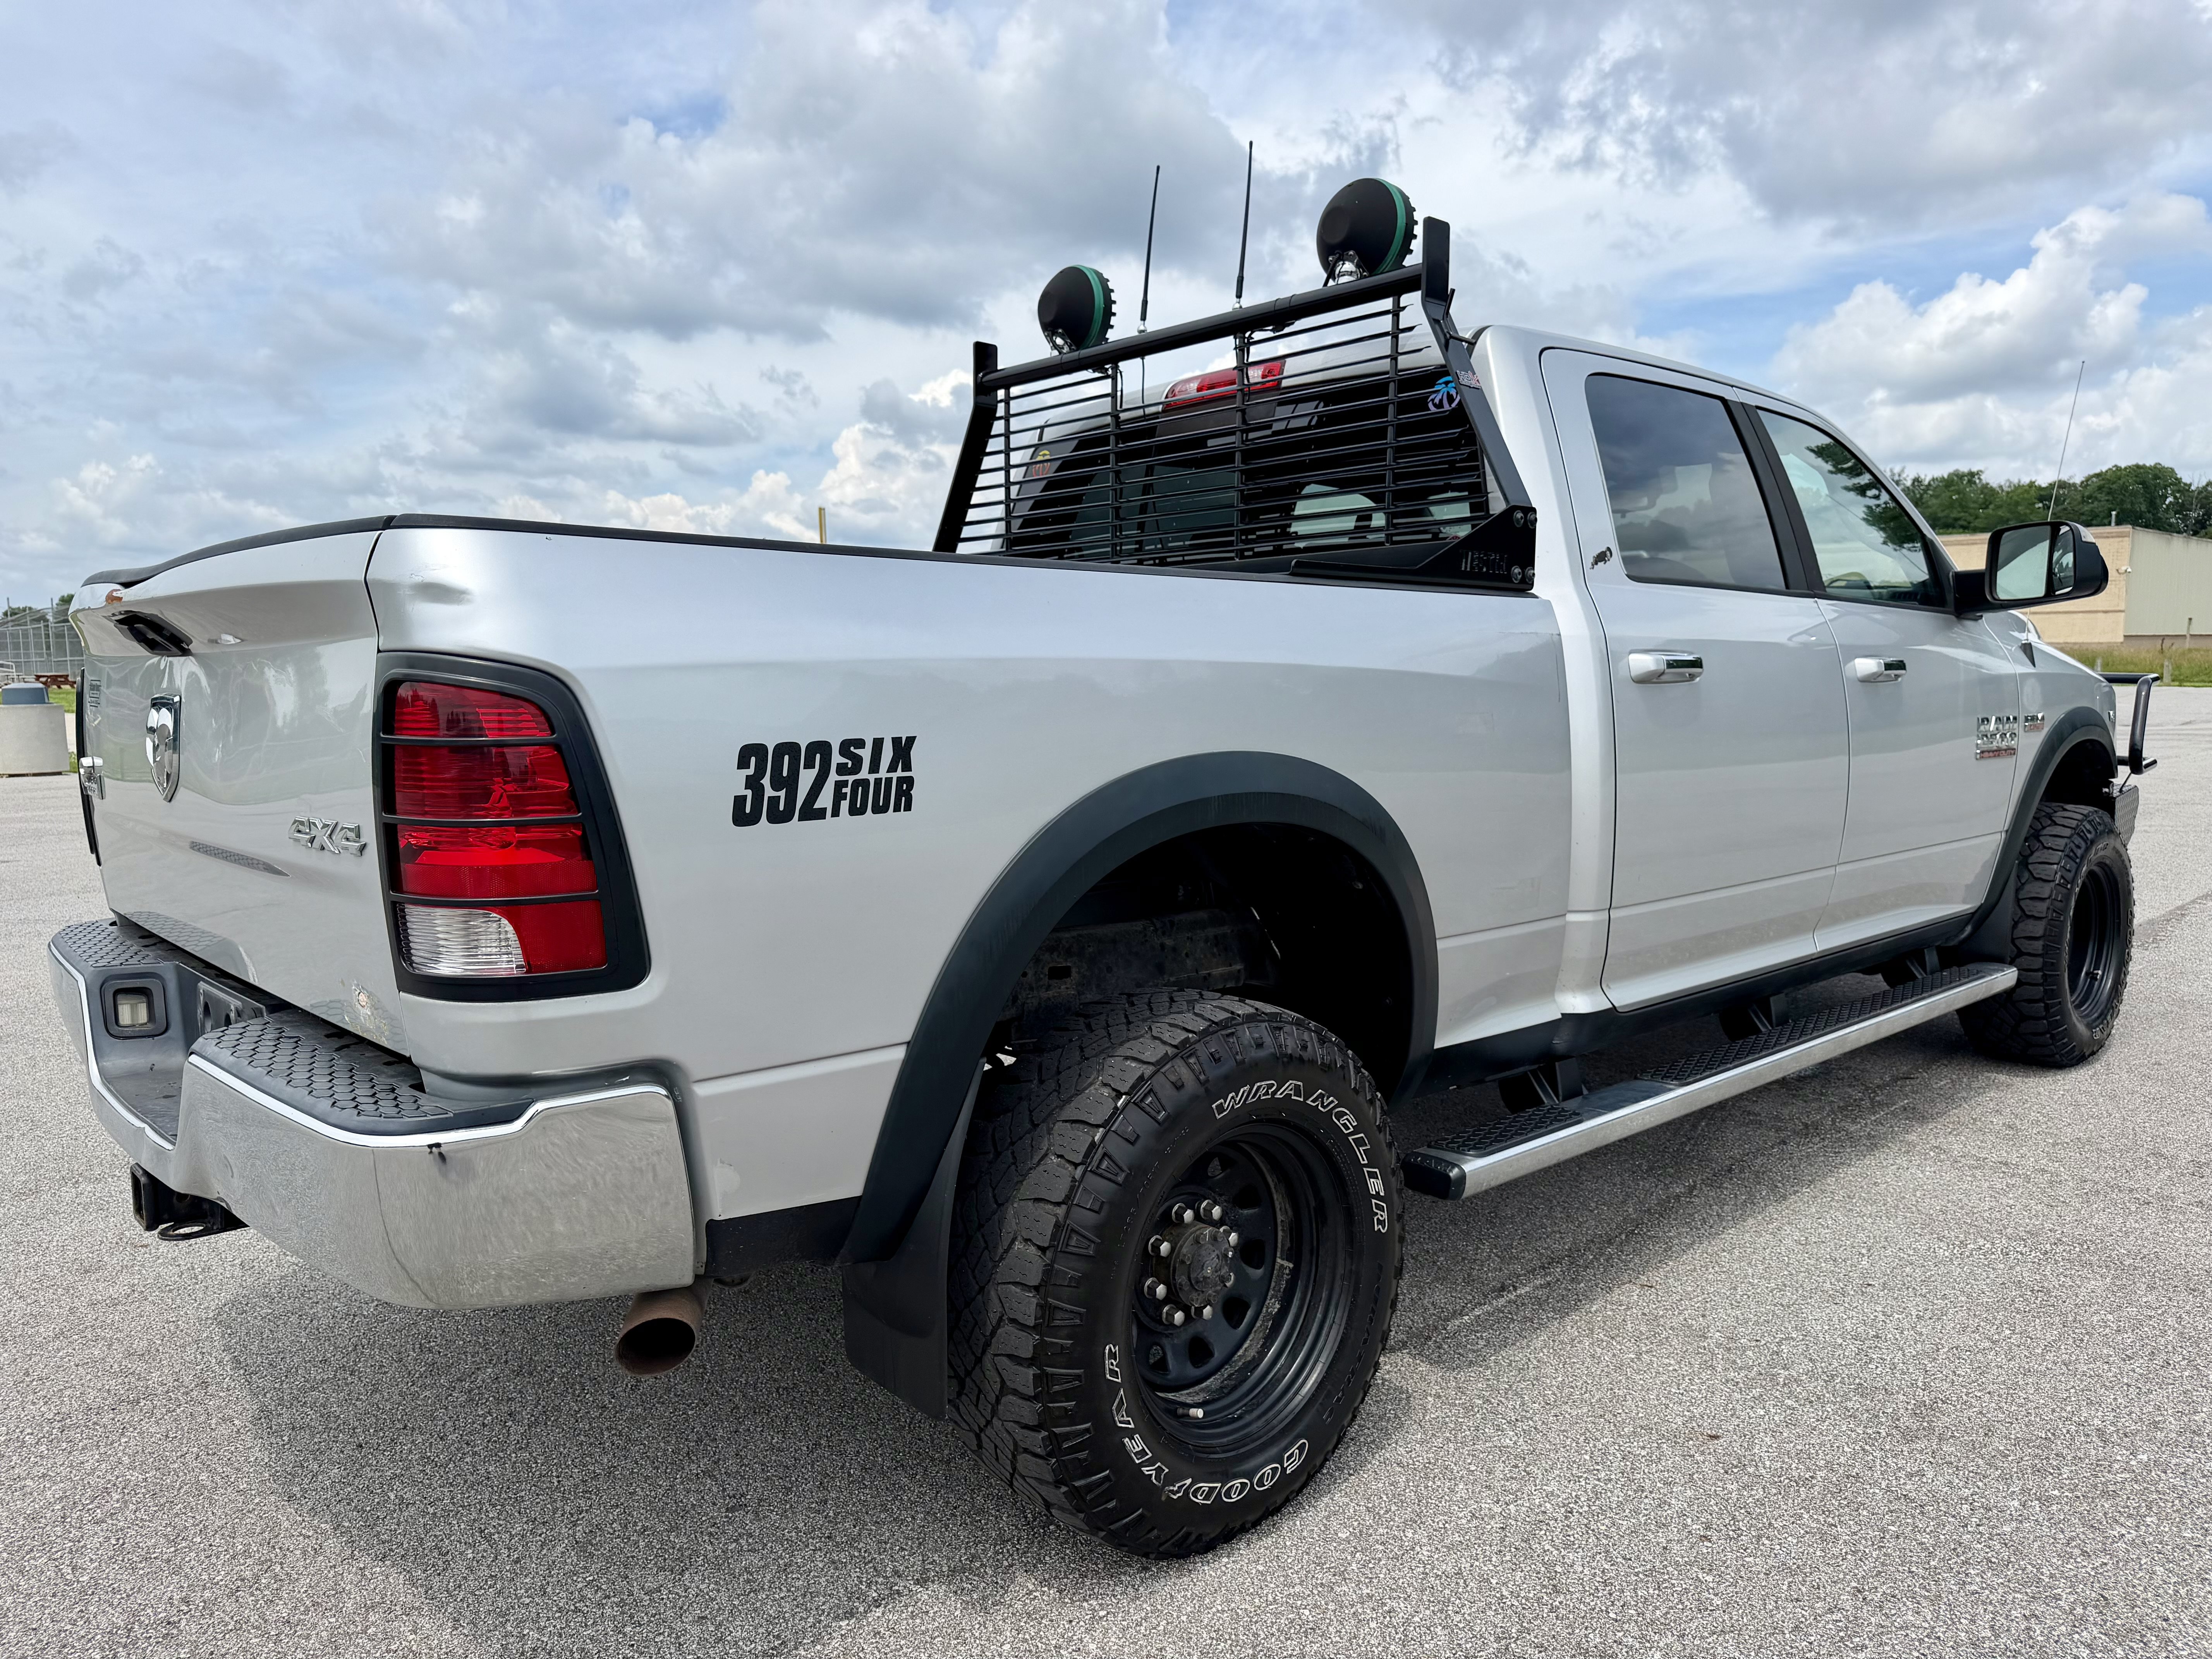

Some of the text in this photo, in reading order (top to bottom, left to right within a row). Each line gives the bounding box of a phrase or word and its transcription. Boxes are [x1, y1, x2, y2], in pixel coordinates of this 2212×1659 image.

[1456, 370, 1481, 386] HDX
[1977, 716, 2017, 731] RAM
[835, 736, 917, 776] SIX
[732, 740, 832, 827] 392
[831, 776, 914, 818] FOUR
[1212, 1080, 1388, 1233] WRANGLER
[1104, 1343, 1308, 1504] GOODYEAR
